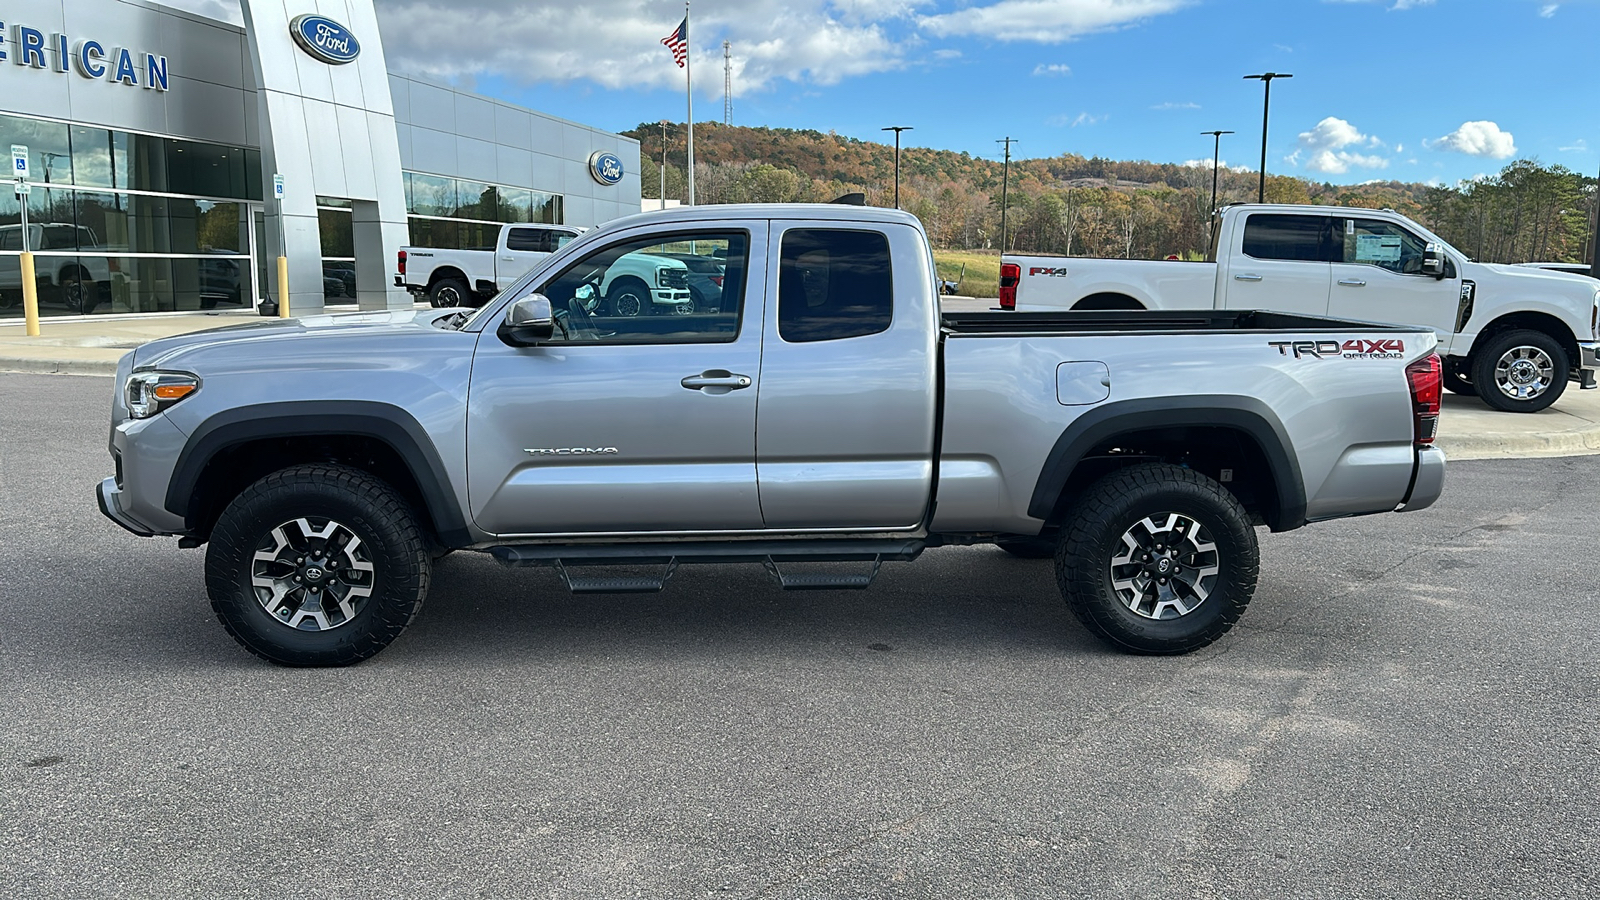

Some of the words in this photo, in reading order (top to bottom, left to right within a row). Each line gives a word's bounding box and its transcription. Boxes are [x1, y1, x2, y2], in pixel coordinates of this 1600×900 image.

[315, 23, 350, 54] Ford
[602, 158, 620, 178] Ford
[1029, 267, 1067, 276] FX4
[523, 446, 619, 456] TACOMA
